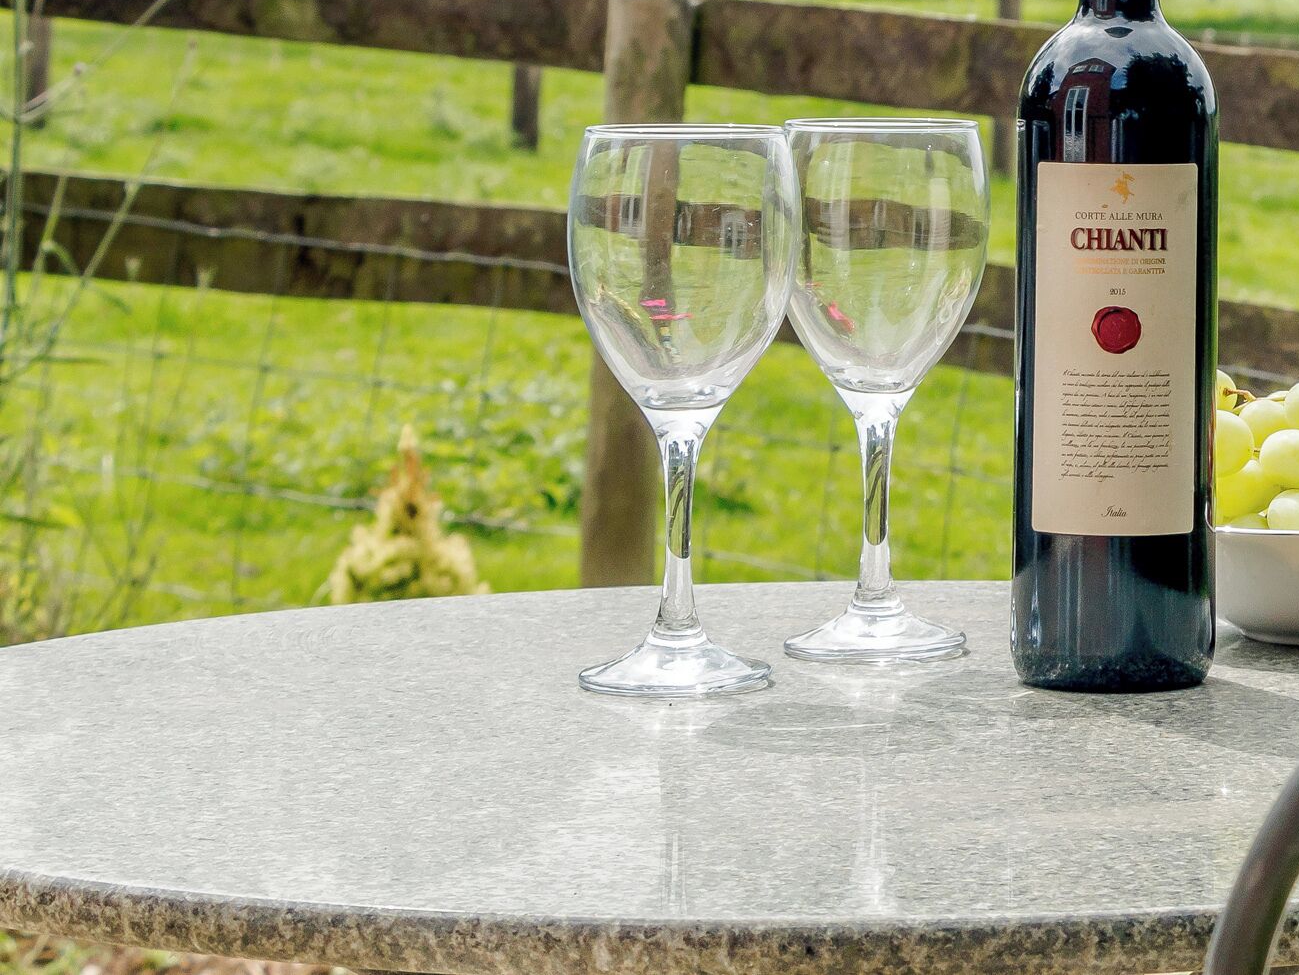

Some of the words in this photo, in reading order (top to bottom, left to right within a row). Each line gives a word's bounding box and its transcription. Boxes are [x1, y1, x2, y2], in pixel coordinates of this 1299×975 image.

[1075, 211, 1107, 221] CORTE
[1108, 212, 1134, 221] ALLE
[1136, 212, 1163, 221] MURA
[1070, 227, 1168, 251] CHIANTI
[1129, 267, 1166, 275] GARANTITA
[1110, 288, 1126, 296] 2015
[1101, 505, 1127, 517] Italia
